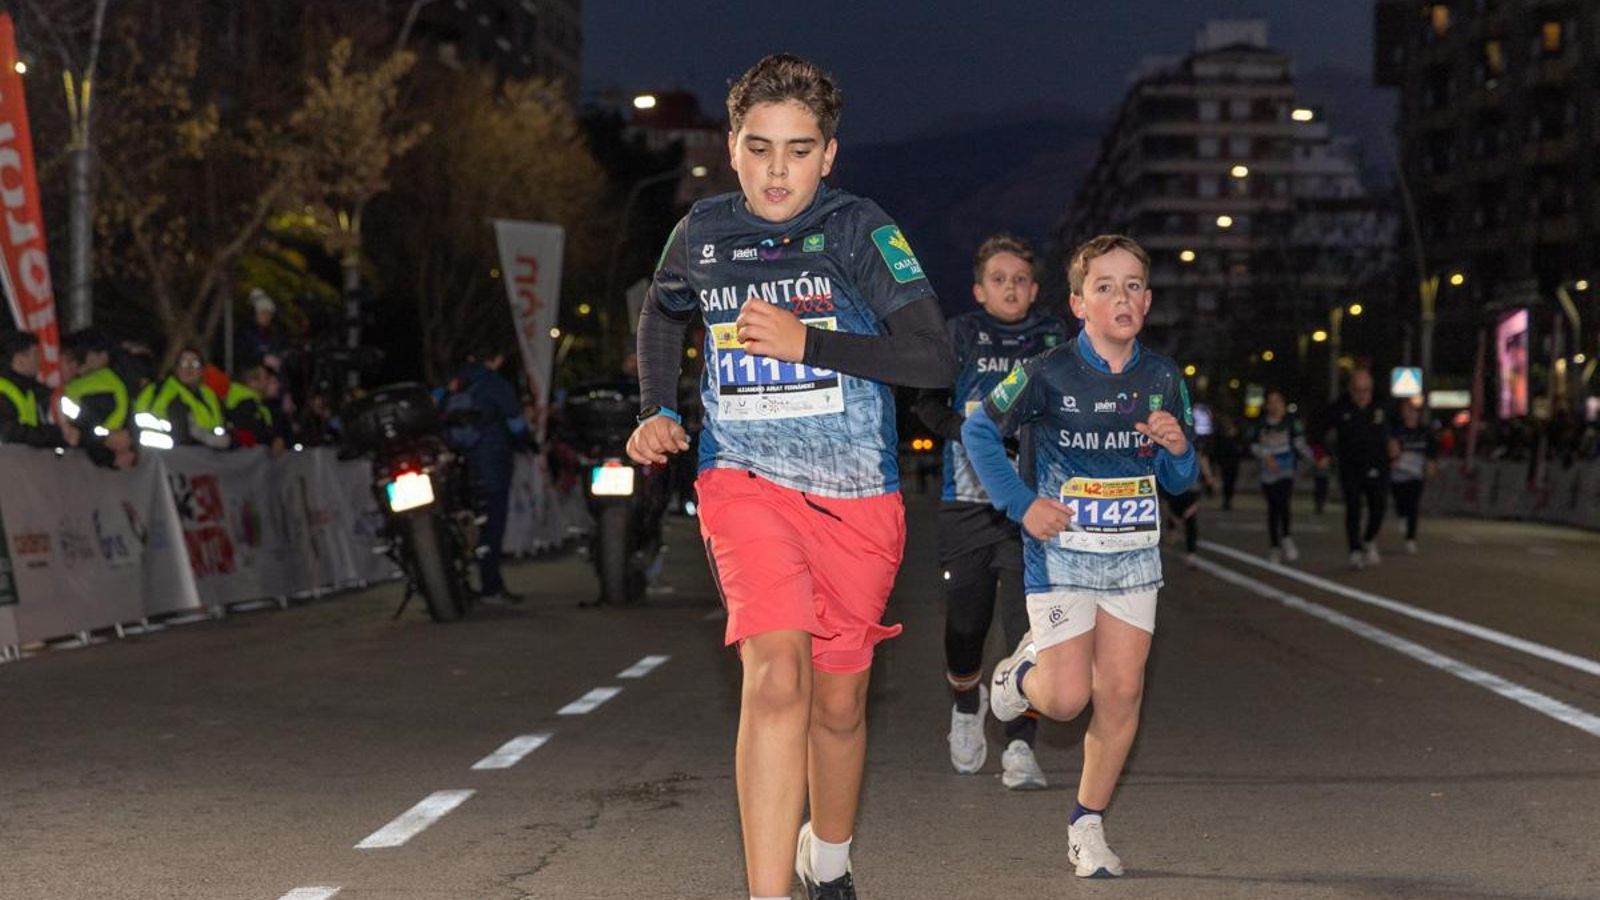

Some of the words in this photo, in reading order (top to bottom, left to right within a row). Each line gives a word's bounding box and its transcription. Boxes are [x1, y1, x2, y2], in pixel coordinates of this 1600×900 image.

[700, 286, 738, 312] SAN
[747, 271, 832, 304] ANTÓN
[791, 293, 834, 316] 2025
[720, 352, 833, 382] 1111
[977, 357, 1009, 373] SAN
[1058, 429, 1100, 450] SAN
[1104, 430, 1154, 450] ANT
[1084, 482, 1103, 495] 42
[1067, 498, 1156, 525] 11422
